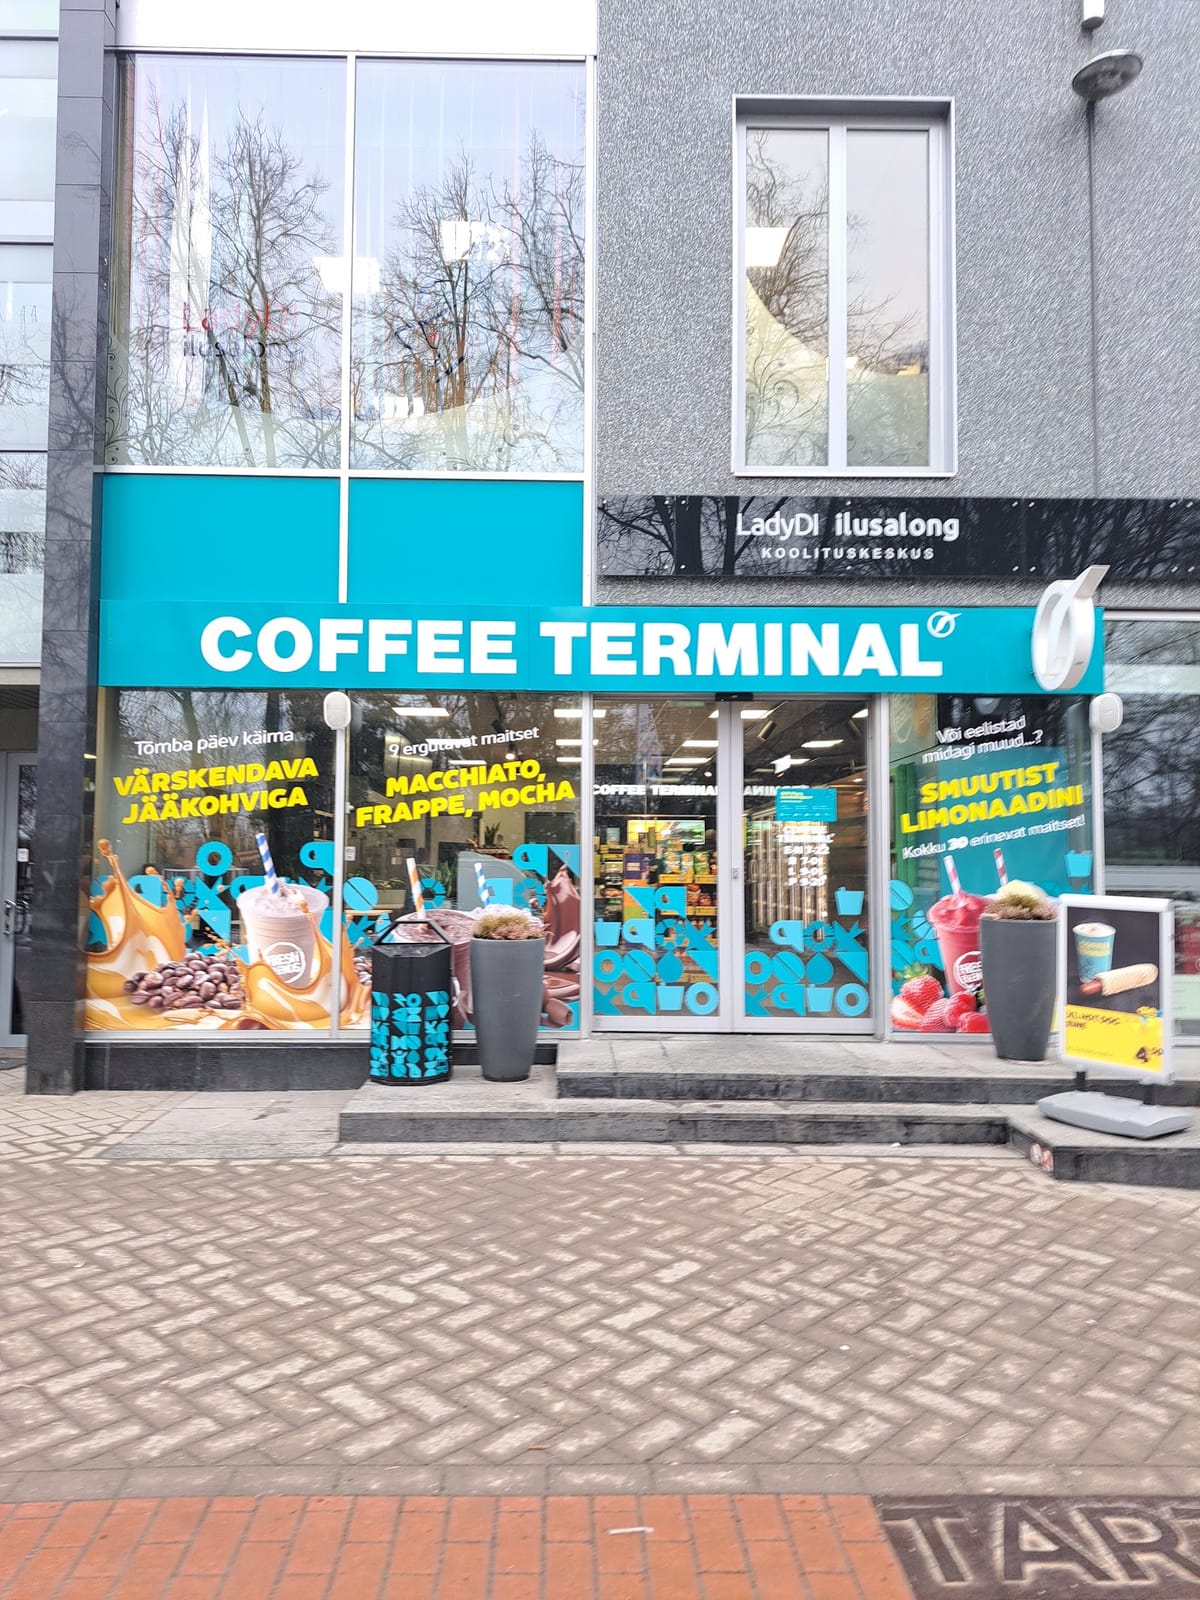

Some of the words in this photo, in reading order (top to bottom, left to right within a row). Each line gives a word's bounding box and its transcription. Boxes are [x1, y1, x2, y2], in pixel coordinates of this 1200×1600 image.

[735, 511, 820, 541] LadyDI
[834, 511, 960, 542] ilusalong
[761, 547, 935, 560] KOOLITUSKESKUS
[200, 616, 518, 675] COFFEE
[539, 621, 943, 677] TERMINAL
[196, 734, 239, 754] päev
[242, 729, 295, 747] käima
[388, 743, 399, 758] 9
[480, 727, 540, 745] maitset
[936, 727, 962, 743] Või
[963, 715, 1026, 740] eelistad
[922, 742, 976, 764] midagi
[112, 757, 320, 797] VÄRSKENDAVA
[386, 759, 546, 798] MACCHIATO,
[920, 762, 1059, 804] SMUUTIST
[121, 786, 308, 825] JÄÄKOHVIGA
[356, 793, 475, 828] FRAPPE,
[477, 779, 577, 812] MOCHA
[900, 785, 1084, 833] LIMONAADINI
[902, 841, 947, 860] Kokku
[969, 827, 1027, 846] erinevat
